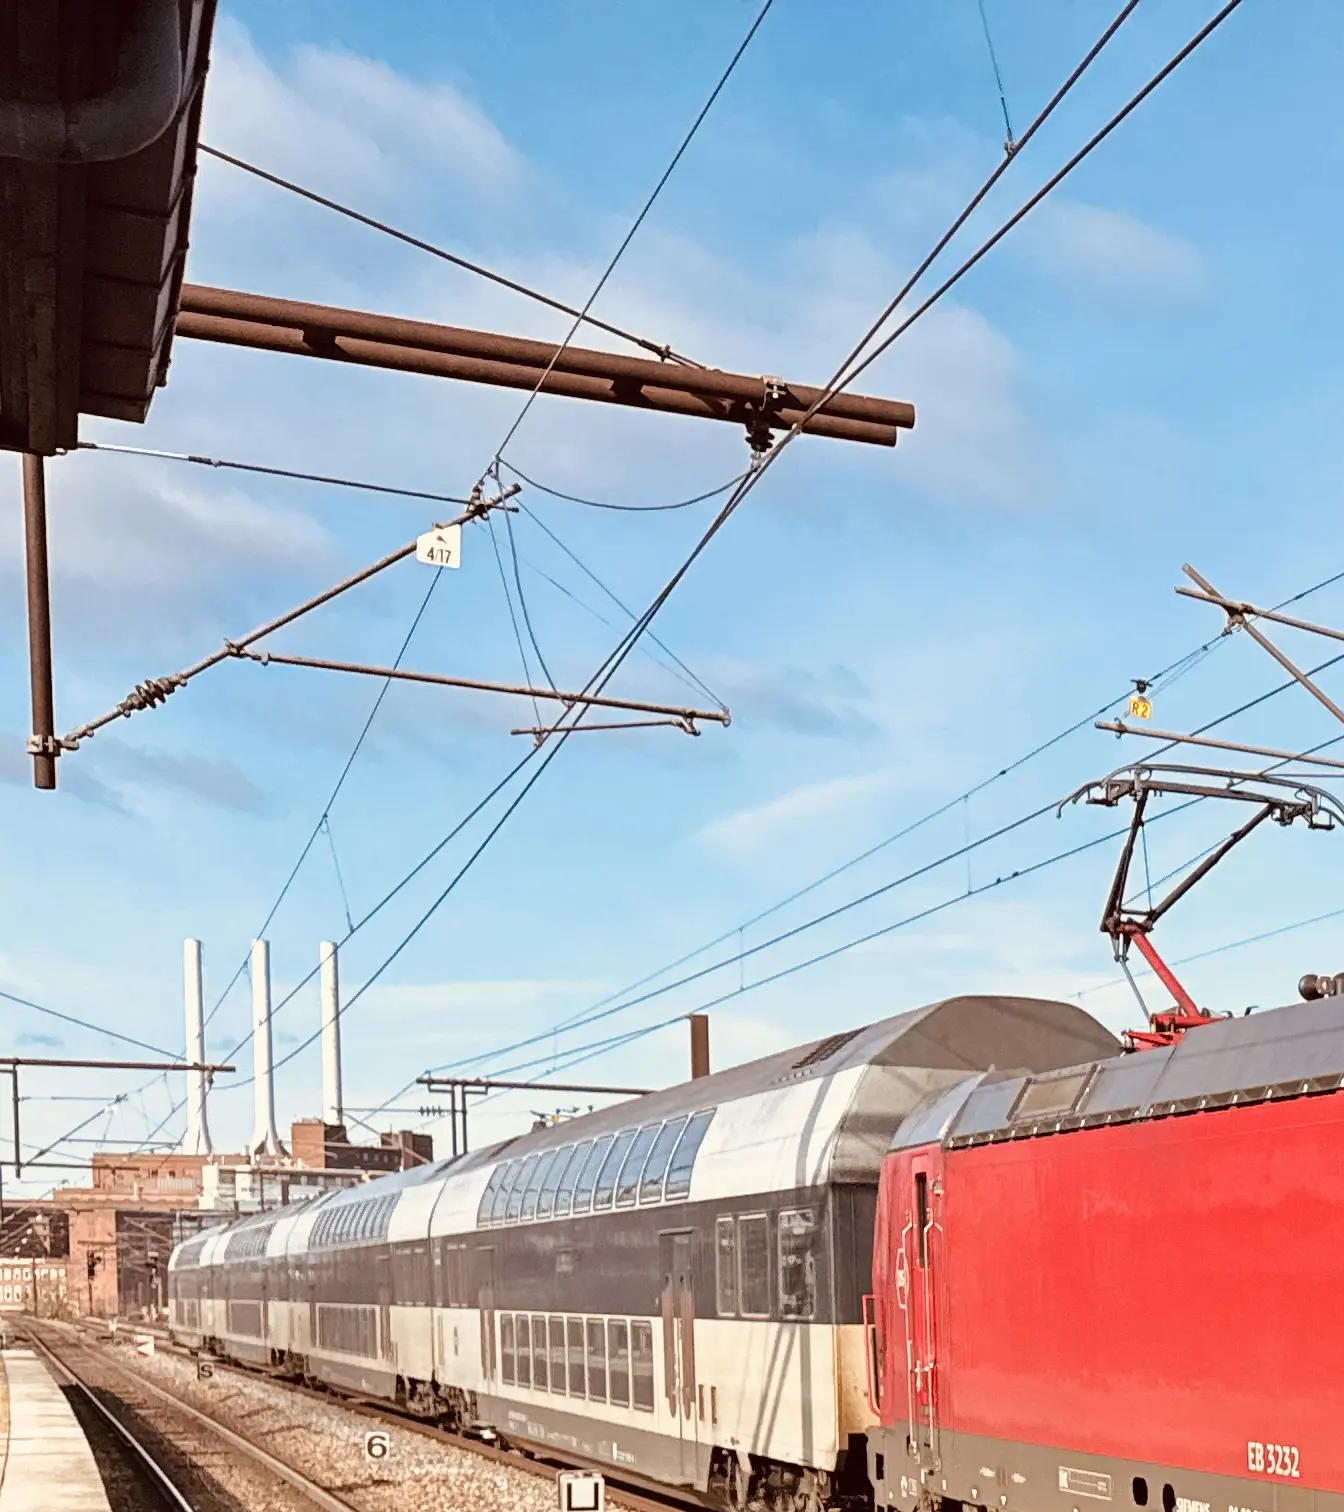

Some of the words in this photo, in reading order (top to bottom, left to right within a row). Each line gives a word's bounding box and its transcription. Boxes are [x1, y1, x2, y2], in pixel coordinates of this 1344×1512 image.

[427, 547, 451, 563] 4/17
[367, 1435, 388, 1459] 6
[1248, 1441, 1265, 1472] EB
[1266, 1443, 1300, 1478] 3232
